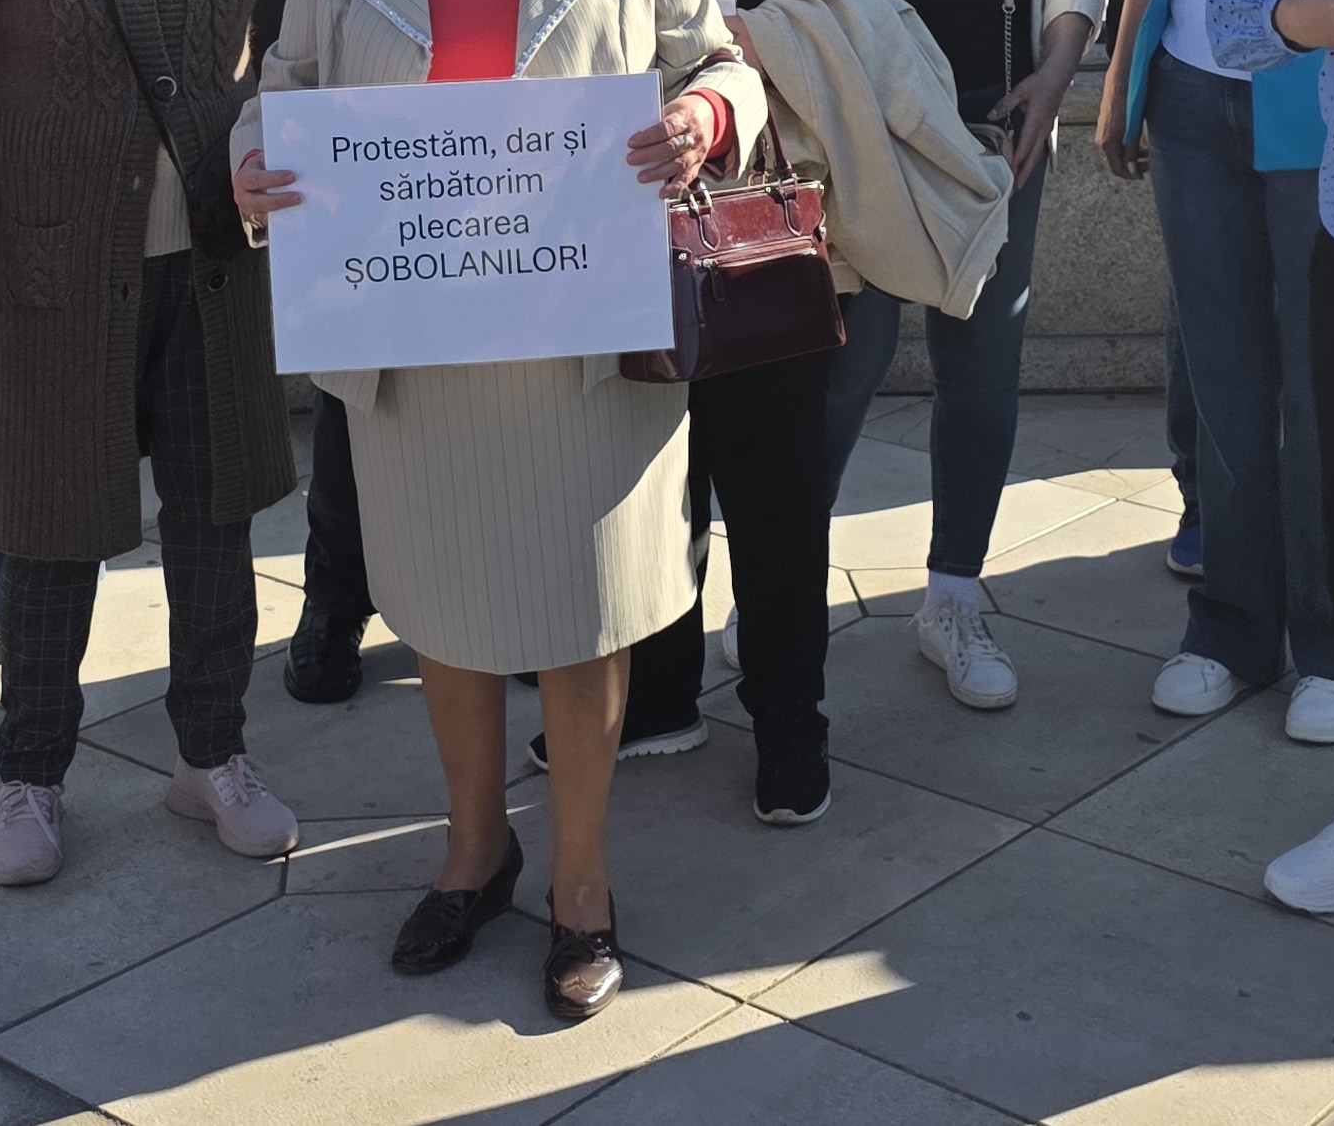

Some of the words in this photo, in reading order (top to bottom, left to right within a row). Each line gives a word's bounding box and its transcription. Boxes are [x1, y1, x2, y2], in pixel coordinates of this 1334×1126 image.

[332, 129, 497, 163] Protestăm,
[506, 127, 554, 154] dar
[563, 123, 587, 157] și
[379, 168, 543, 201] sărbătorim
[399, 213, 530, 246] plecarea
[345, 243, 588, 290] ȘOBOLANILOR!
